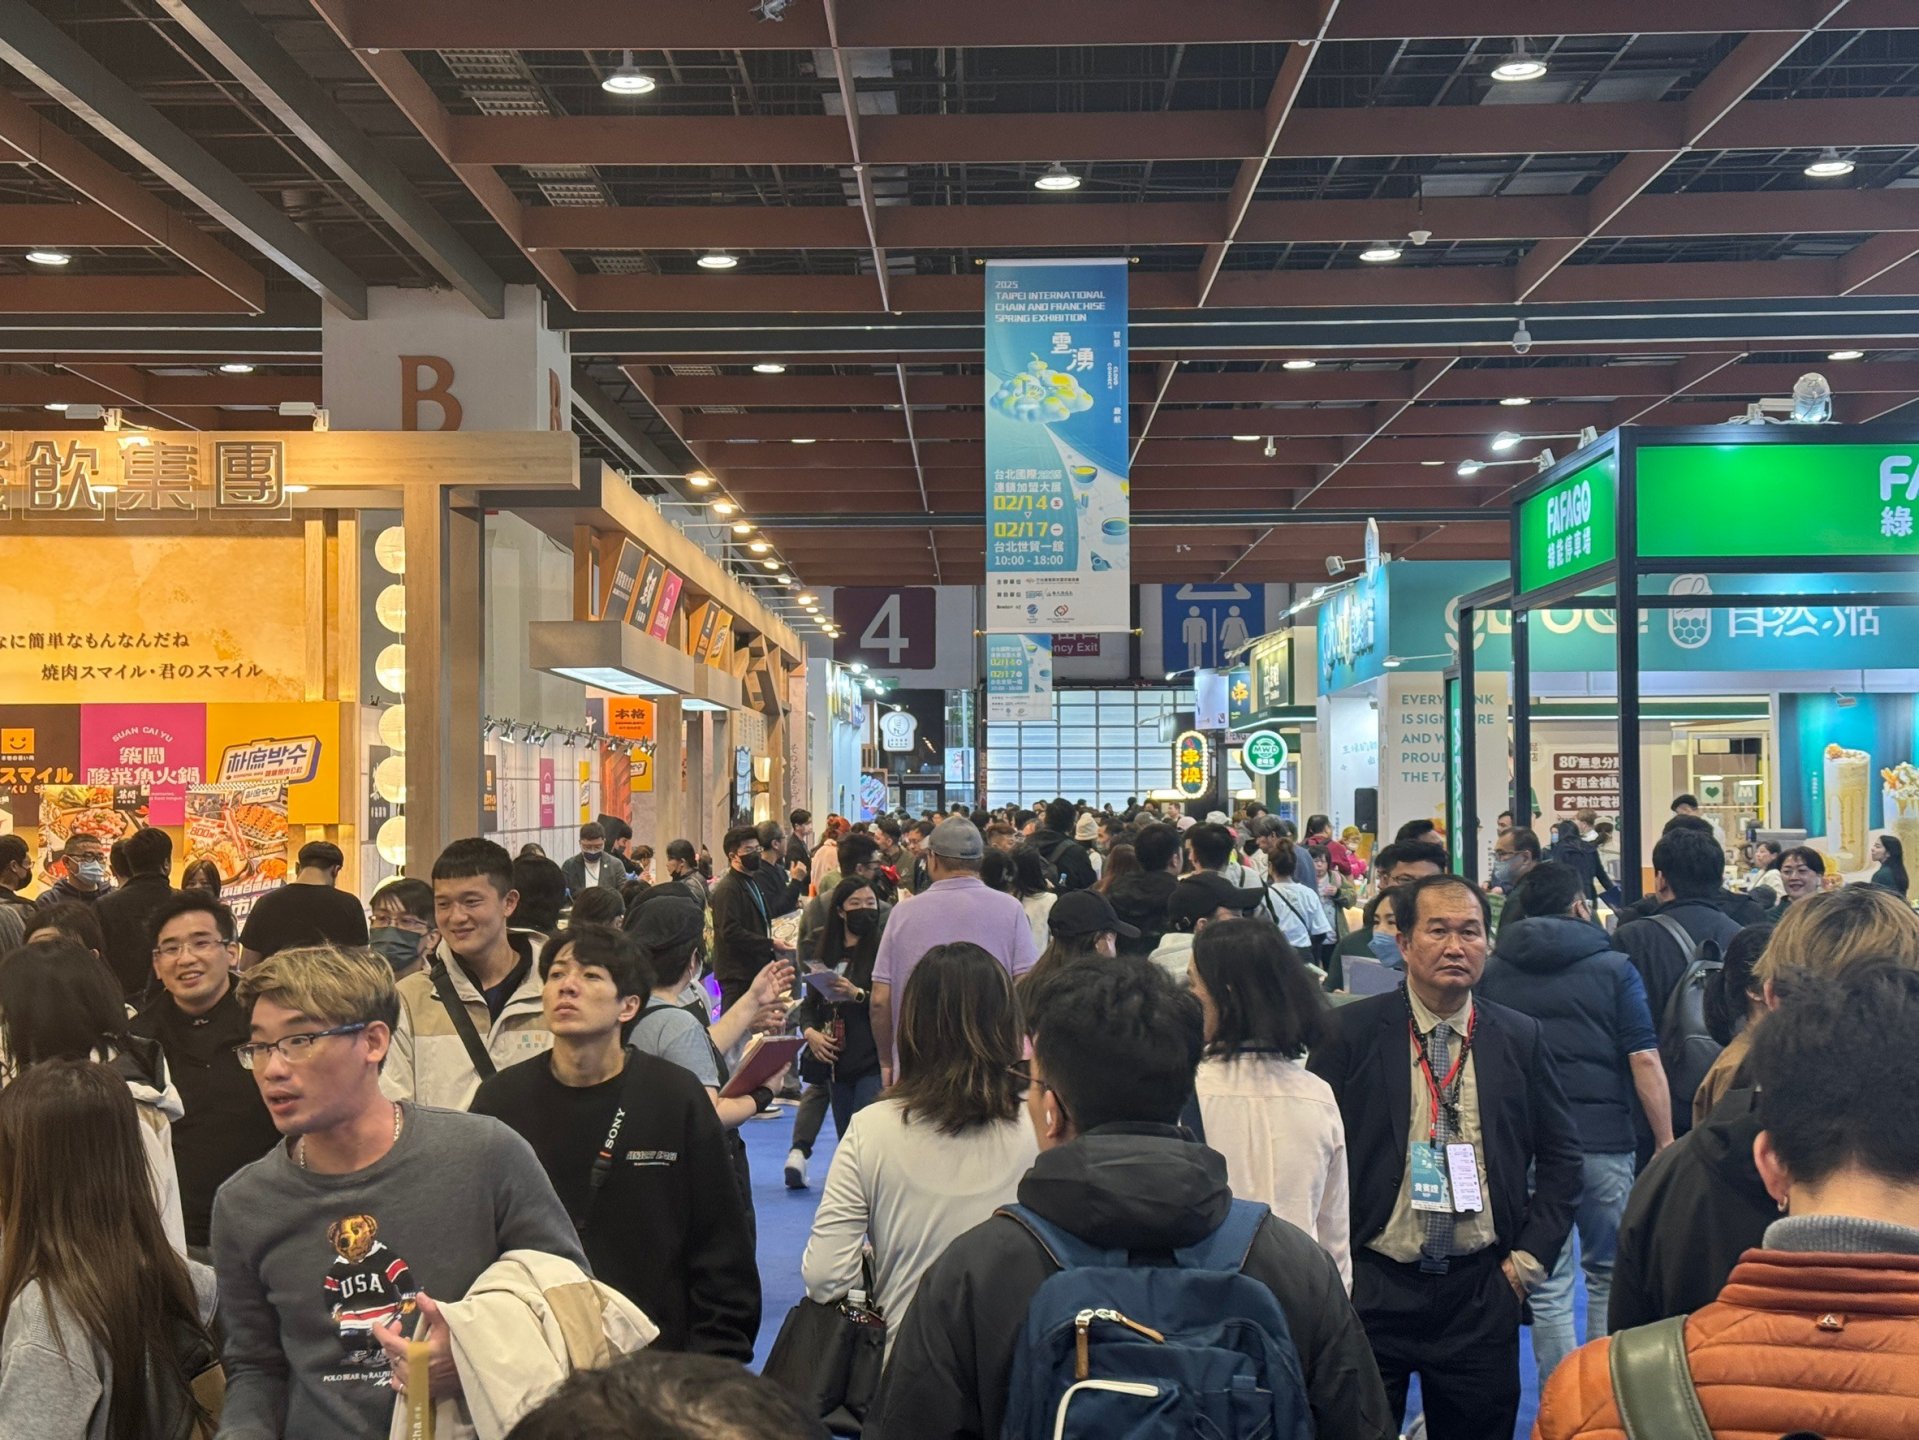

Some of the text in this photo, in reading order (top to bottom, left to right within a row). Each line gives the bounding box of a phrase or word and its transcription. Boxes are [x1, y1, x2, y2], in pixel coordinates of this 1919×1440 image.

[995, 280, 1018, 289] 2025
[995, 290, 1106, 300] TAIPEI INTERNATIONAL
[995, 301, 1106, 312] CHAIN AND FRANCHISE
[995, 313, 1087, 323] SPRING EXHIBITION
[398, 355, 462, 431] B
[0, 440, 285, 511] 飲集團
[994, 495, 1048, 511] 02/14
[1547, 480, 1591, 539] FAFAGO
[994, 522, 1048, 538] 02/17
[994, 555, 1024, 566] 10:00
[1034, 555, 1064, 566] 18:00
[860, 594, 909, 663] 4
[1053, 642, 1098, 654] ncy Exit
[1402, 695, 1444, 704] EVERY
[1402, 714, 1415, 724] IS
[112, 726, 174, 743] SUAN CAI YU
[1402, 733, 1431, 743] AND
[1402, 752, 1446, 763] PROU
[88, 767, 200, 785] 酸菜魚火鍋
[1402, 772, 1429, 782] THE
[605, 1107, 625, 1149] SONY
[341, 1273, 384, 1299] USA
